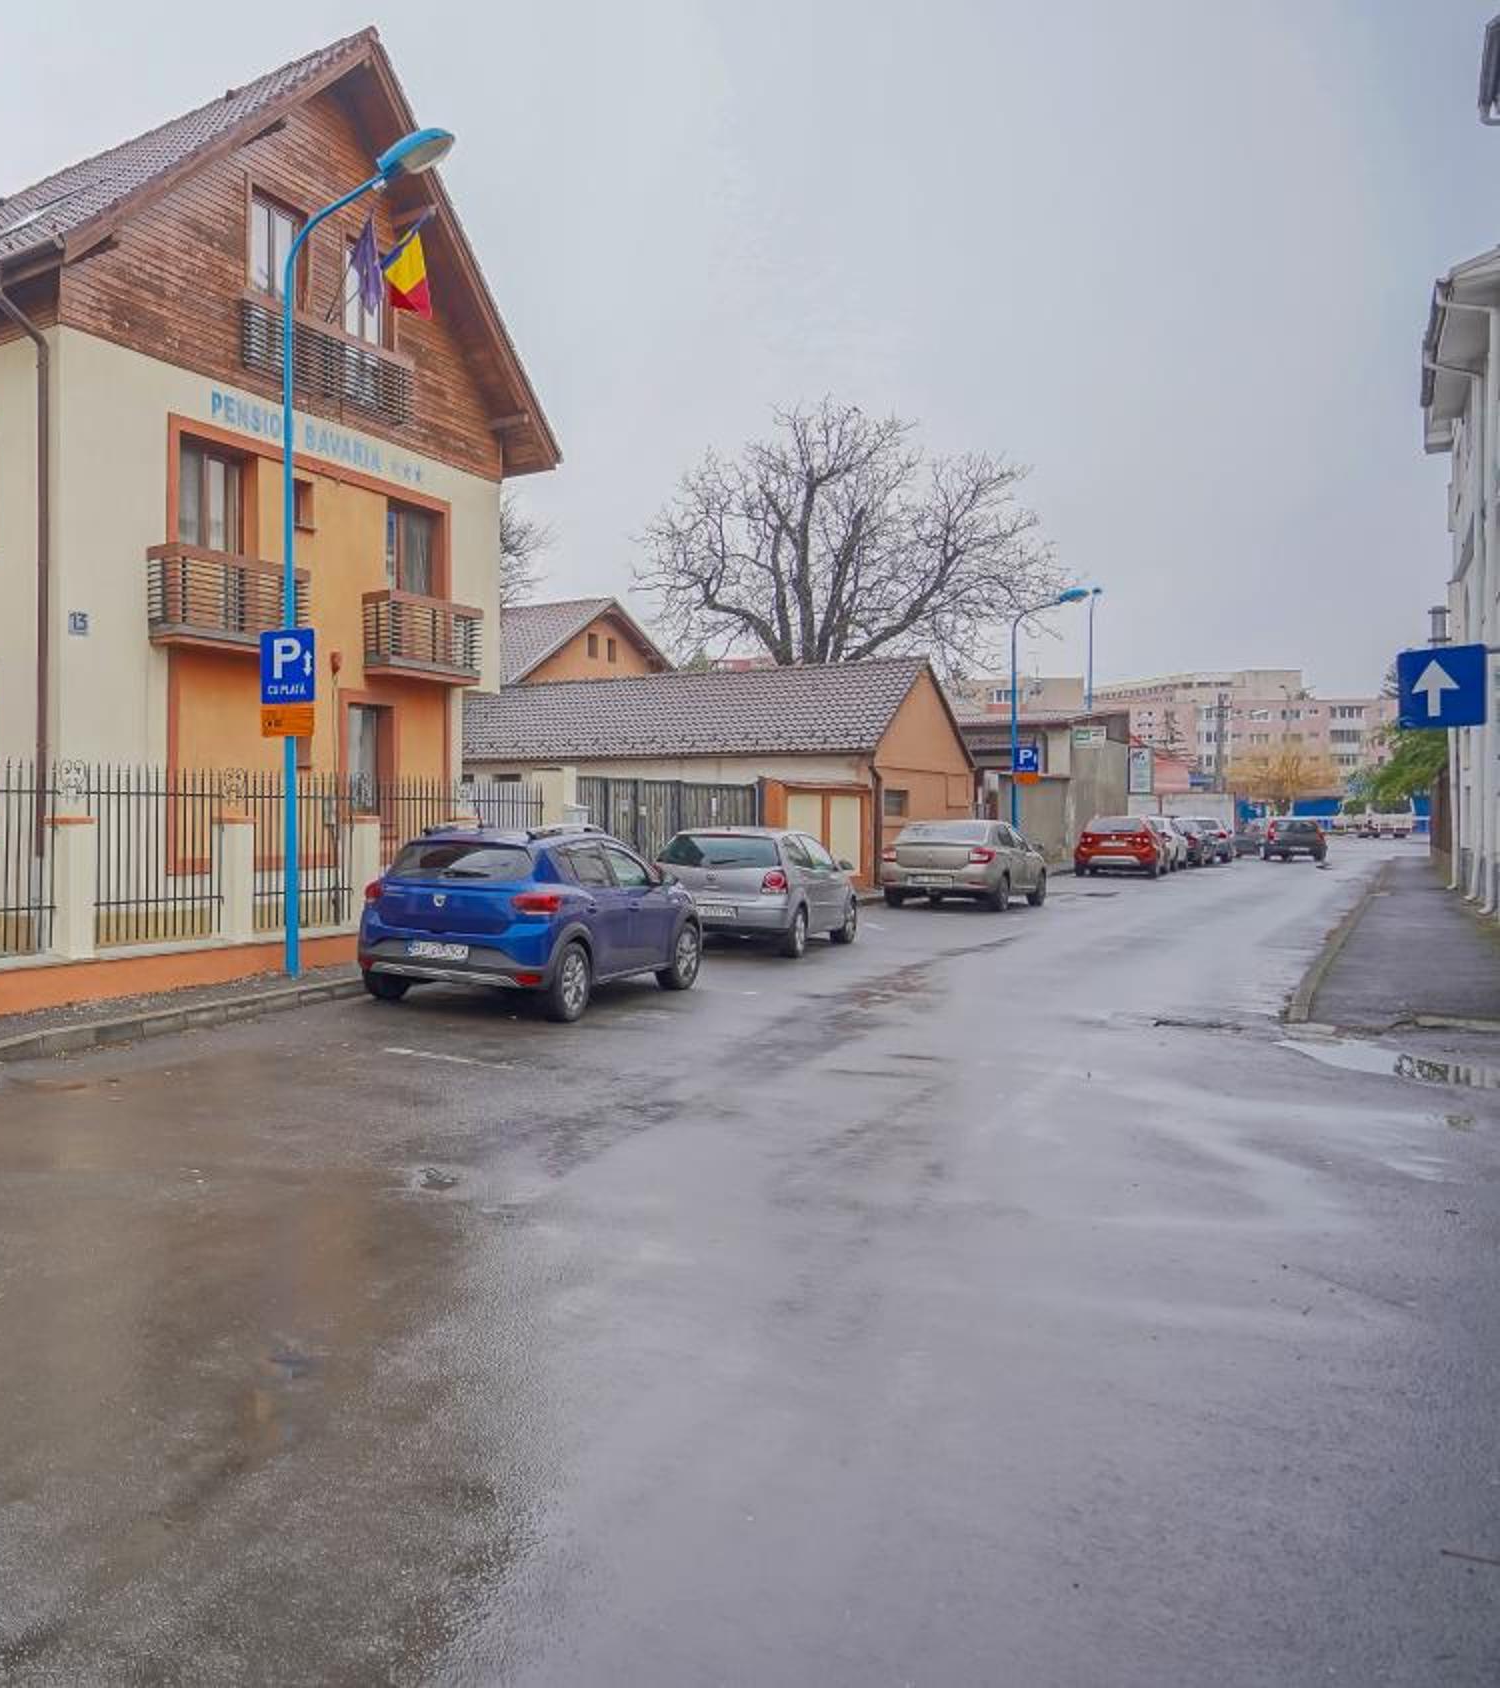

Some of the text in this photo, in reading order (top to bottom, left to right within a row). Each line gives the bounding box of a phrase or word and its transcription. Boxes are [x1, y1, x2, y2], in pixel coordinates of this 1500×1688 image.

[304, 421, 382, 473] BAVARIA
[274, 638, 301, 679] P
[1019, 749, 1033, 765] P
